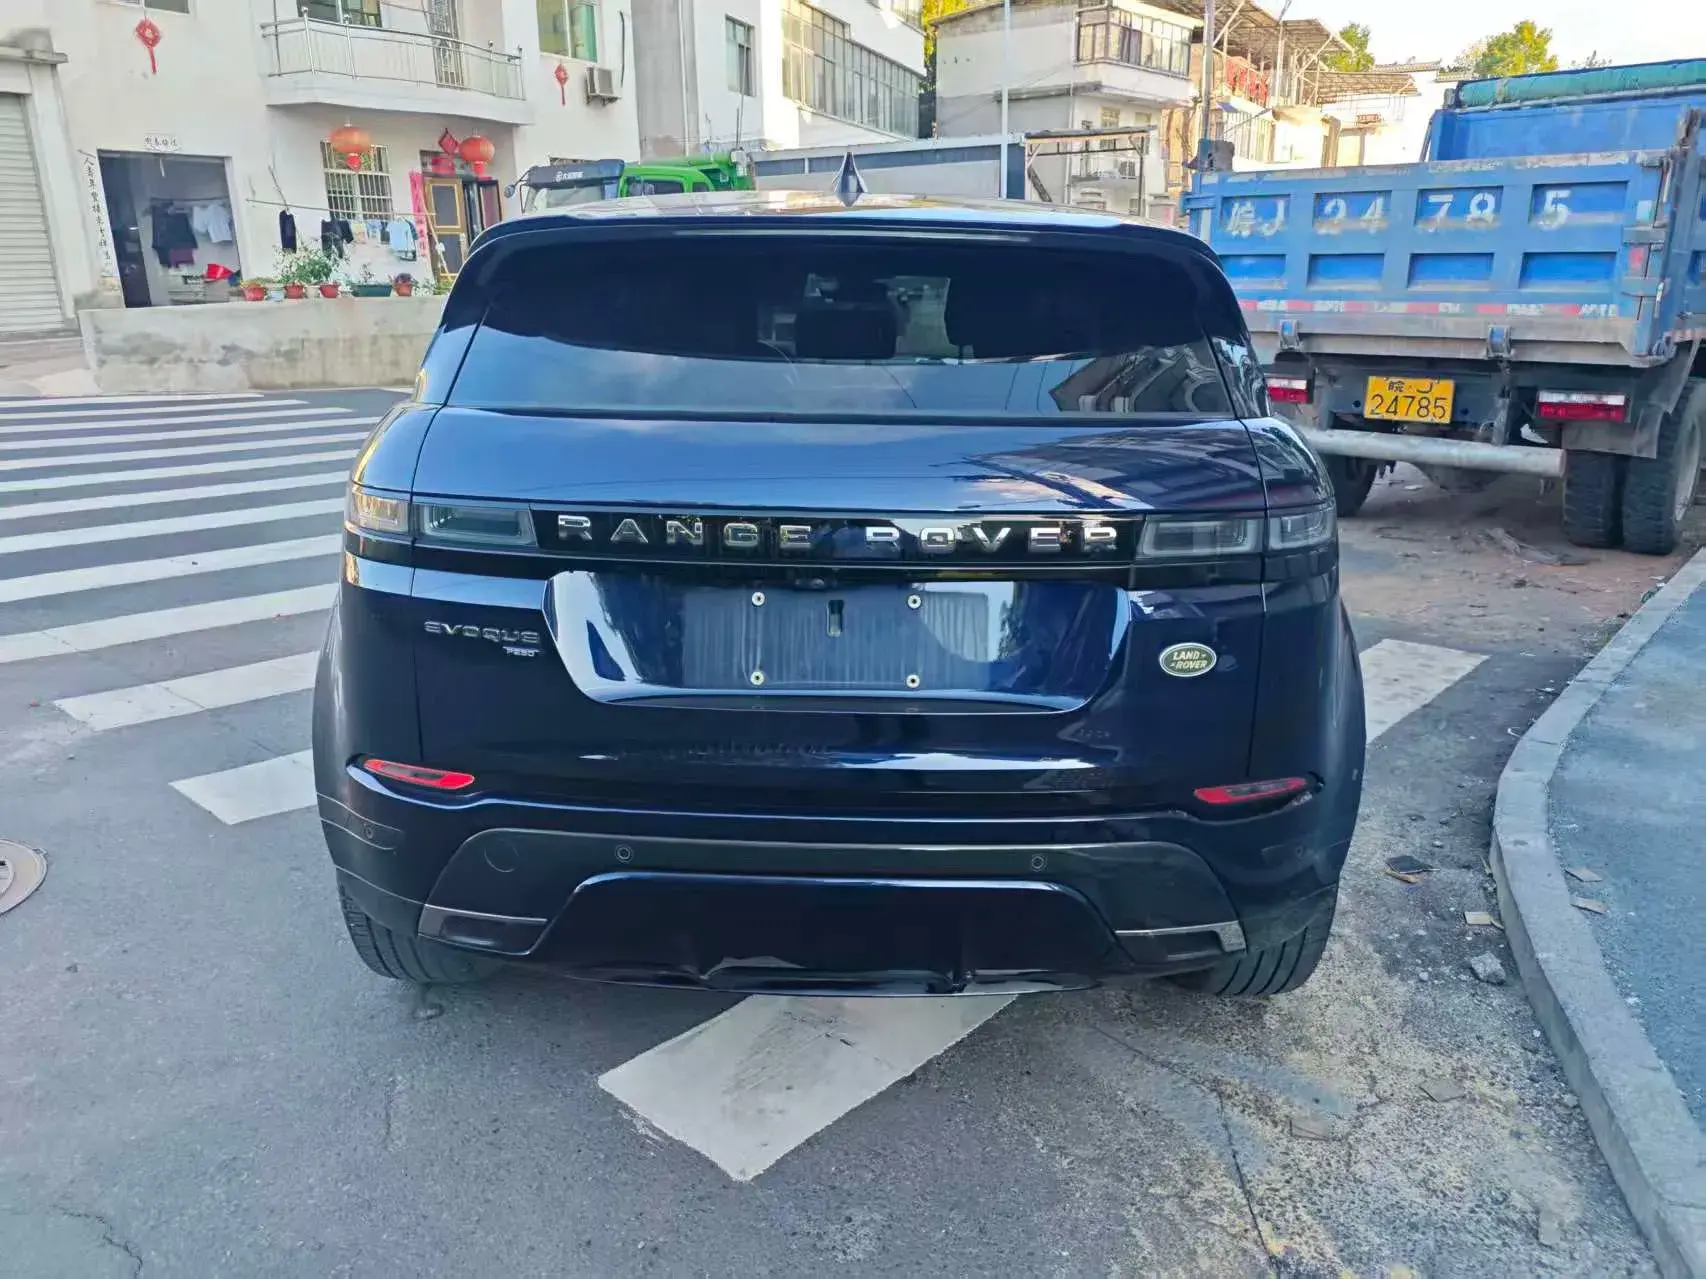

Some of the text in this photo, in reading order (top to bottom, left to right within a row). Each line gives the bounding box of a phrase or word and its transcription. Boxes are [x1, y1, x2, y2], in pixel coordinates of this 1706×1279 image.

[1370, 393, 1447, 419] 24785
[556, 513, 1118, 555] RANGE ROVER
[424, 620, 541, 644] EVOQUE
[1173, 650, 1201, 660] LAND
[1175, 660, 1208, 670] ROVER
